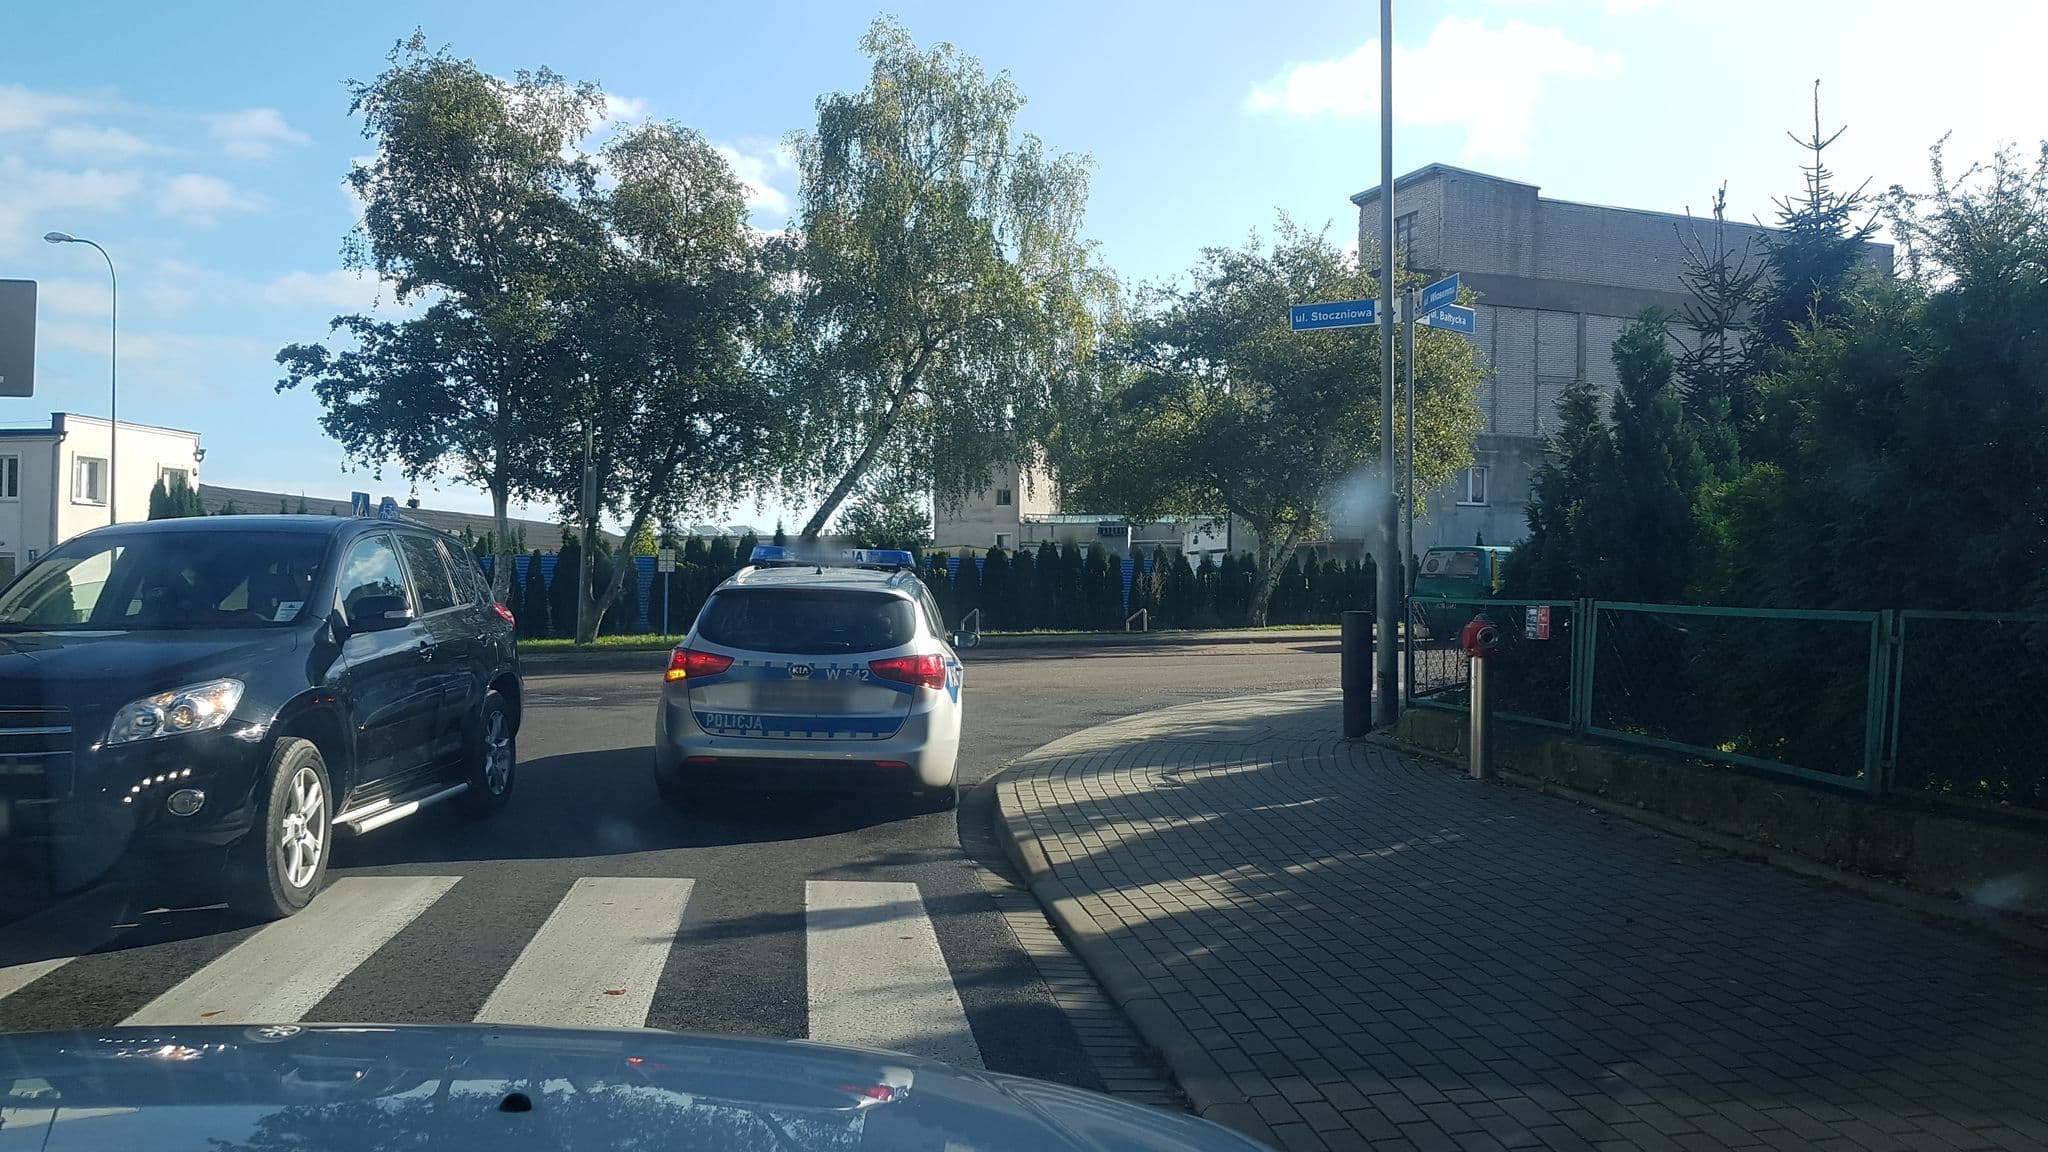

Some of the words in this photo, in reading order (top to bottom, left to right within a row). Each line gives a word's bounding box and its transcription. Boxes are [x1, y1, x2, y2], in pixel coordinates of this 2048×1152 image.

[1295, 312, 1308, 323] ul.
[1311, 309, 1372, 322] Stoczniowa
[792, 666, 809, 675] KIA
[826, 668, 841, 681] W
[705, 713, 763, 729] POLICJA
